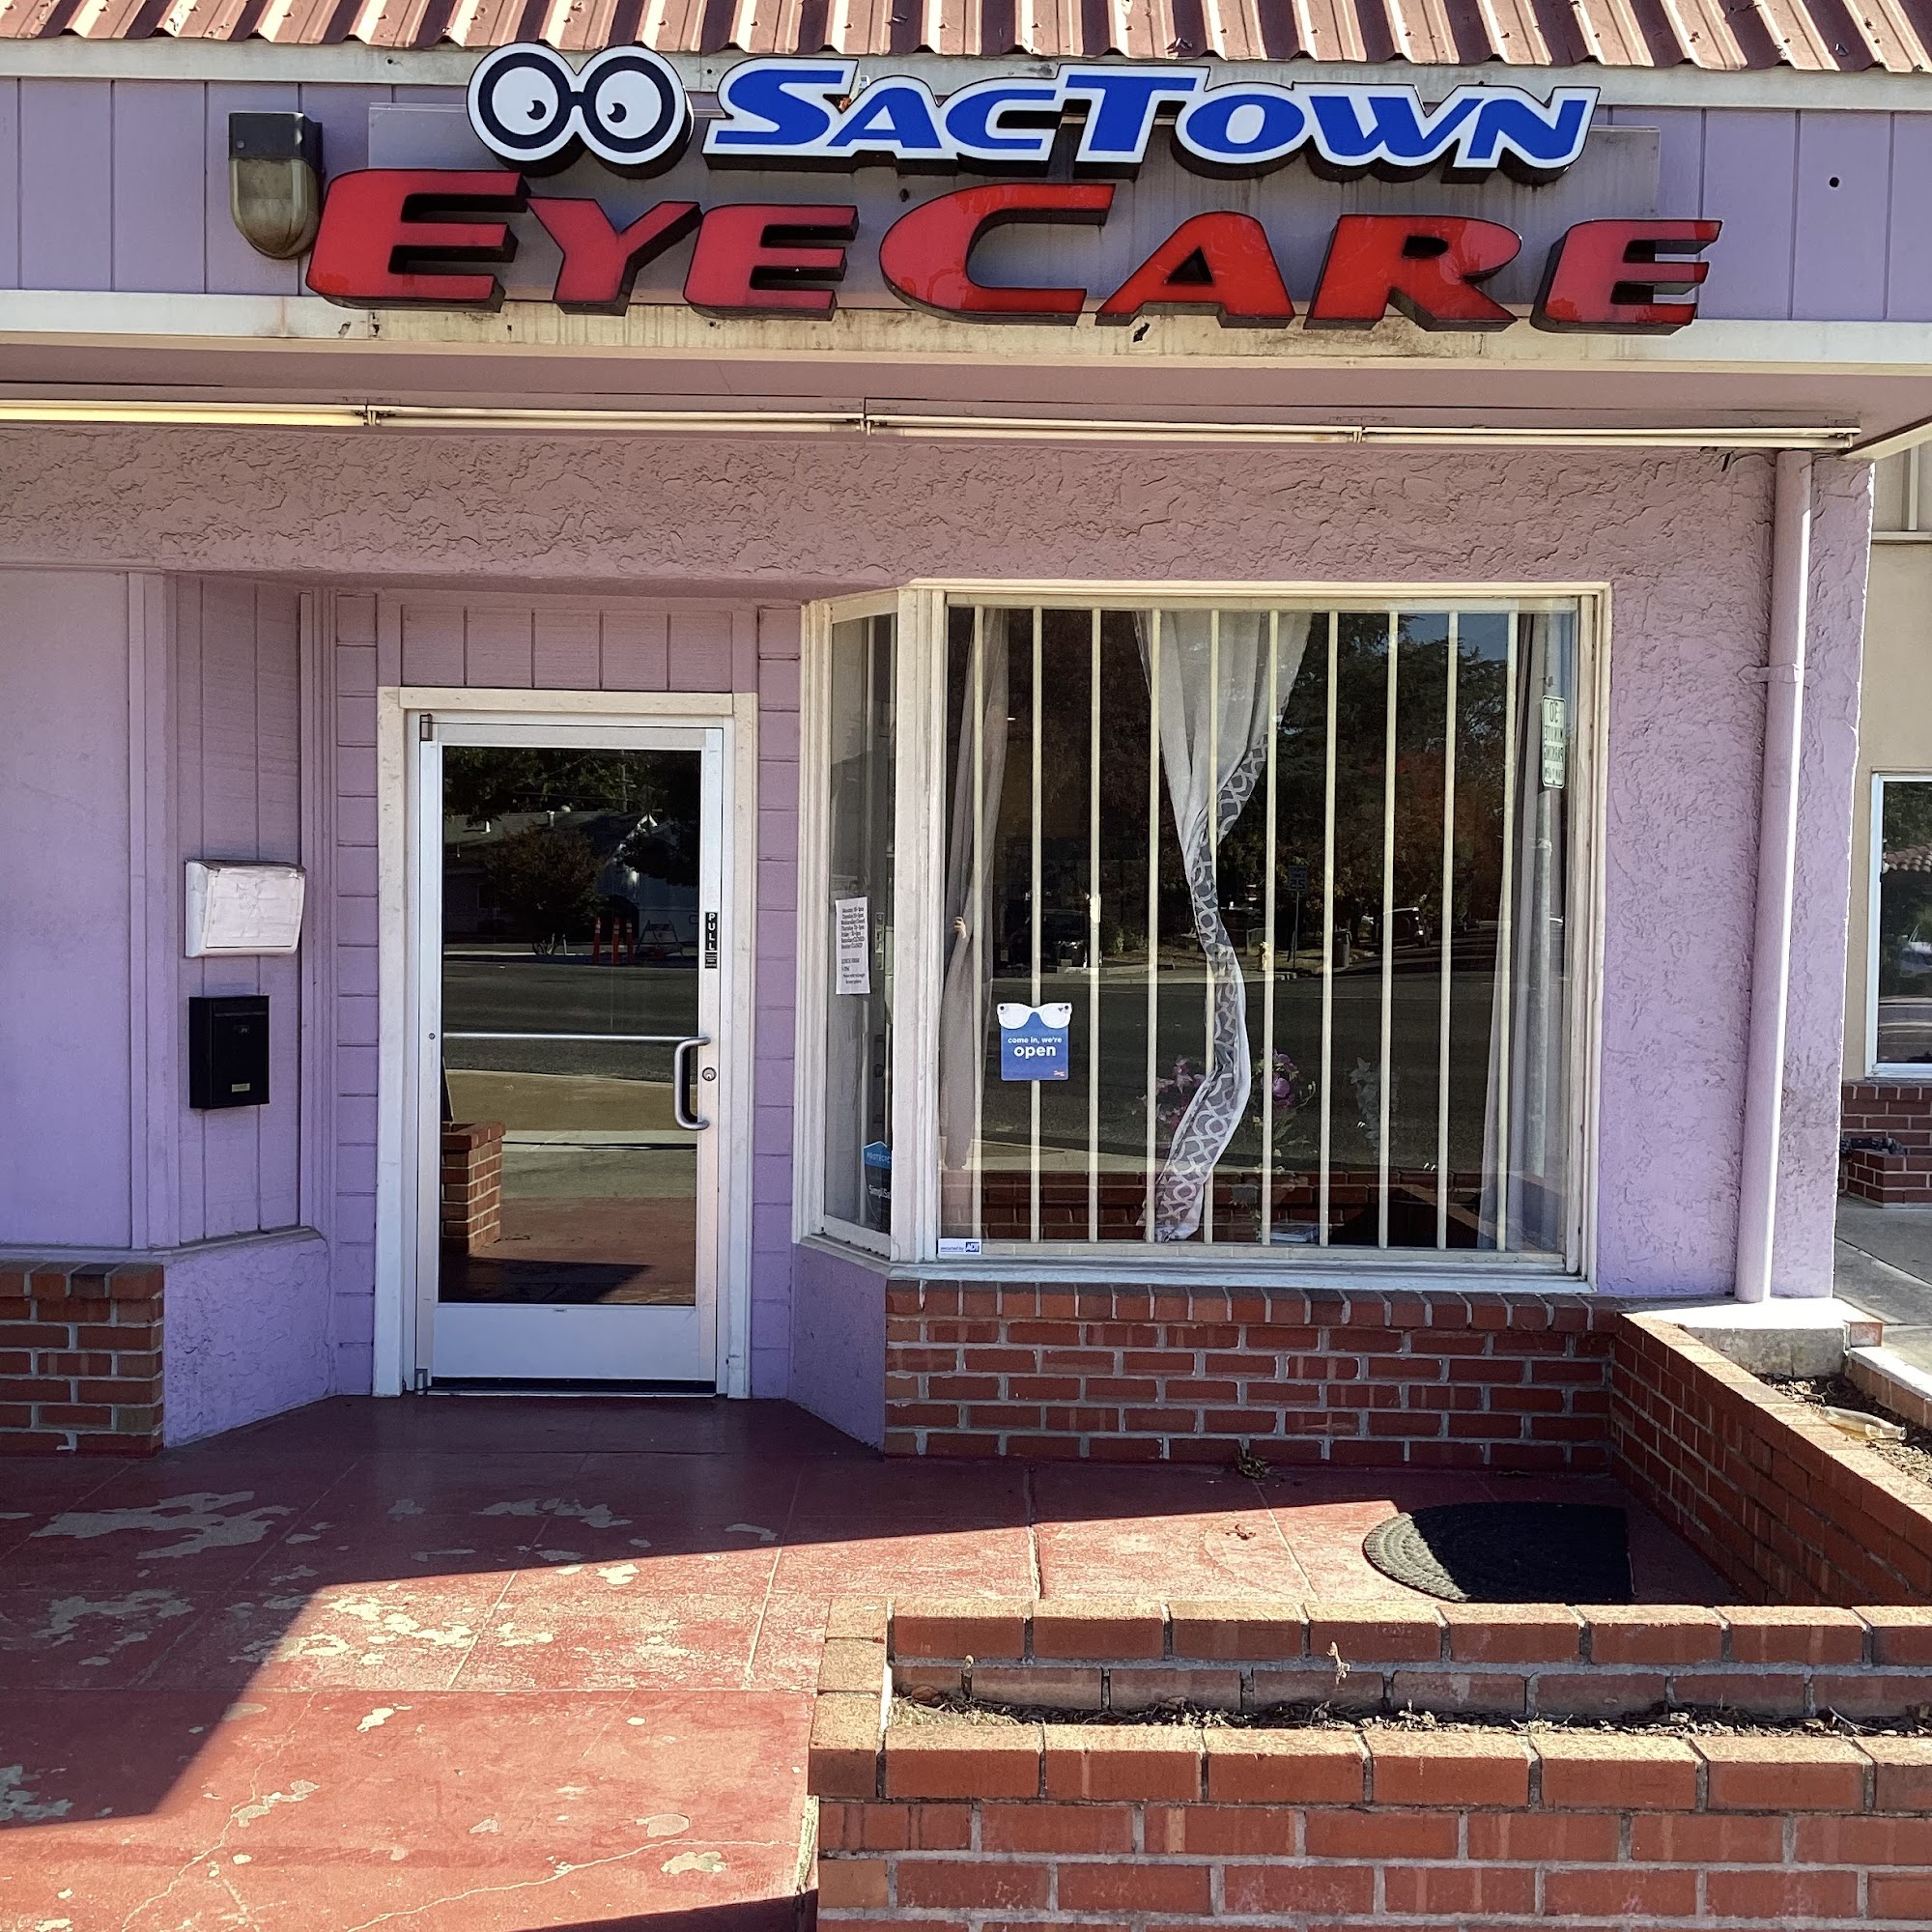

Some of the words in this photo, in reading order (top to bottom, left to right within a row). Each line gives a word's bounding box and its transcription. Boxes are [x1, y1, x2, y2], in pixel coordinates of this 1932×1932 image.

[1030, 1036, 1040, 1044] in,
[1013, 1045, 1057, 1060] open
[965, 1242, 980, 1252] ADT
